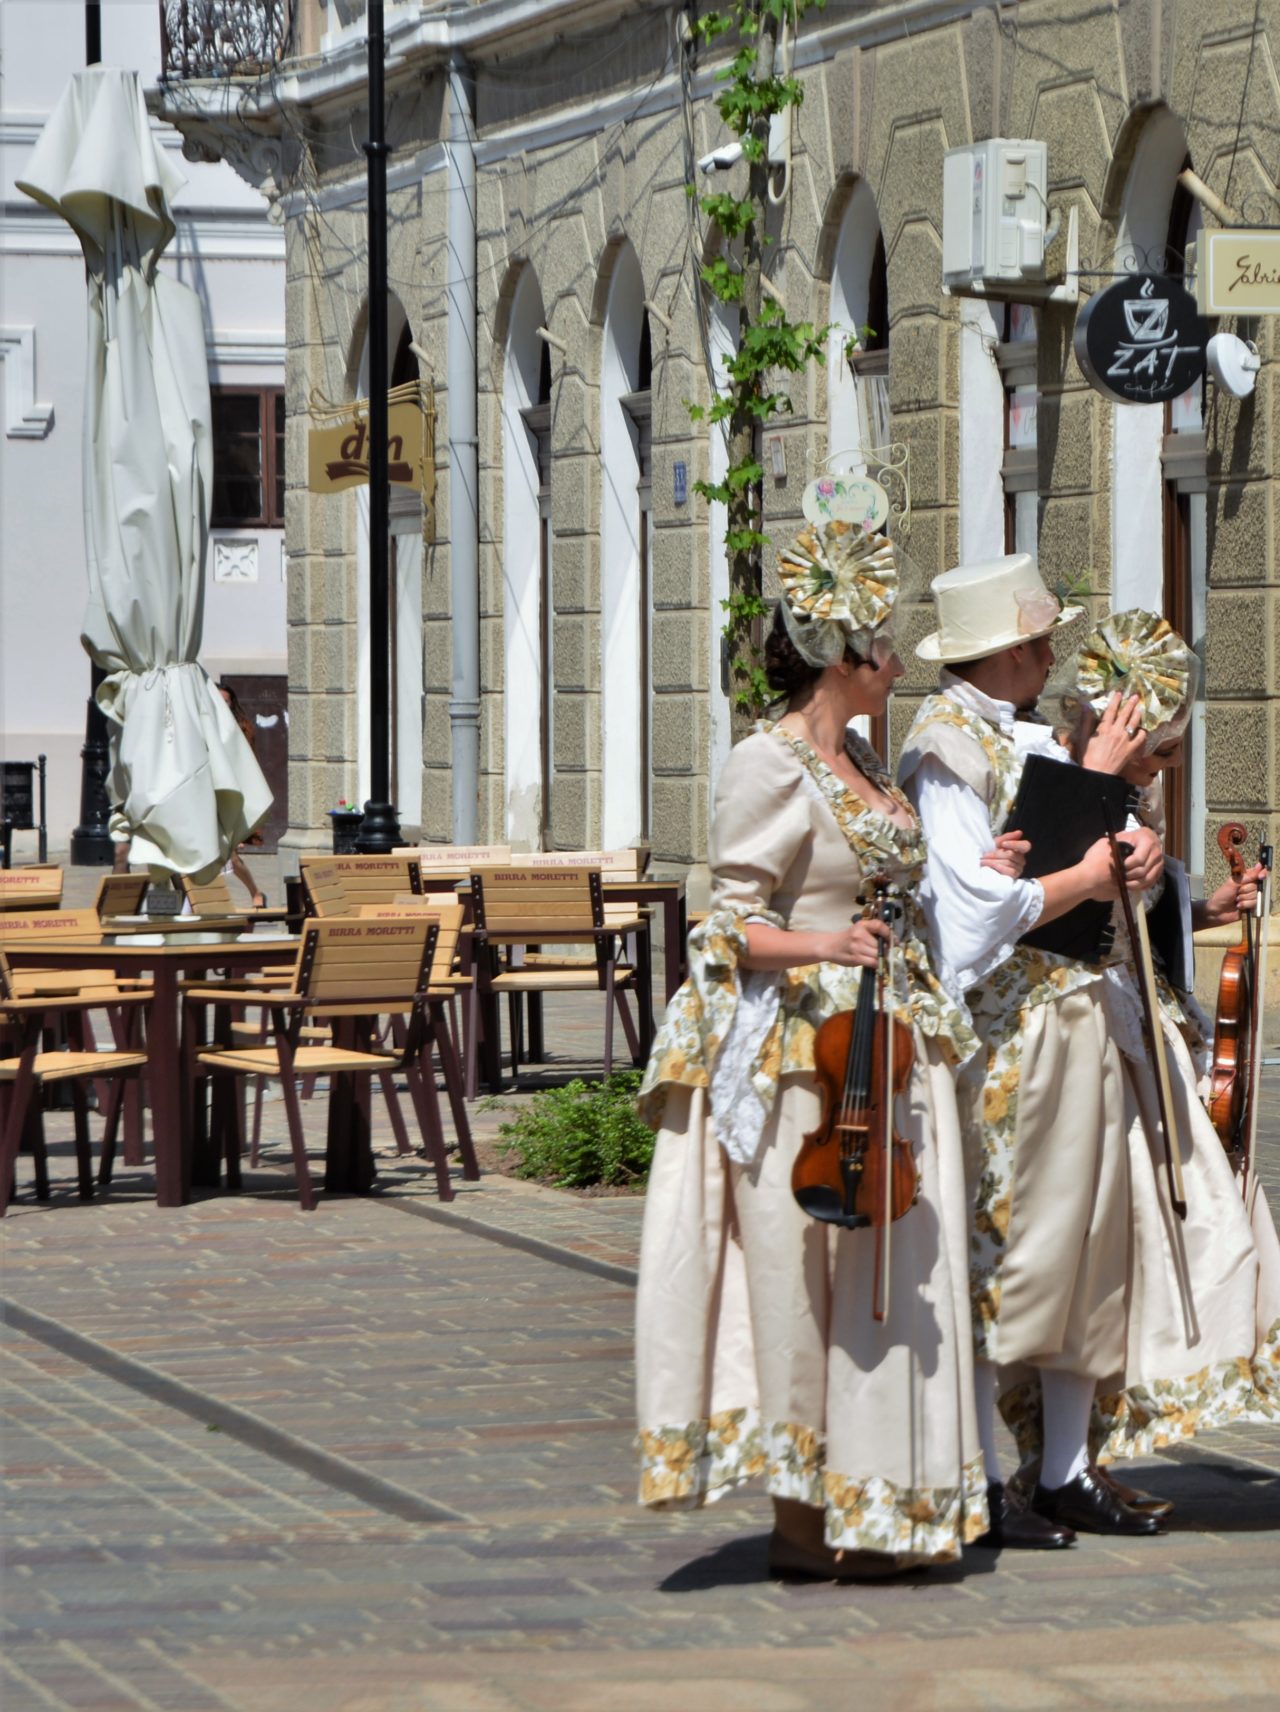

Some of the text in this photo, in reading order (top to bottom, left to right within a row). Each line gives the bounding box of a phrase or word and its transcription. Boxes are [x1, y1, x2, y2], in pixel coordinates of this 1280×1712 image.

[1106, 345, 1201, 382] ZAT
[355, 862, 400, 871] MORETTI
[494, 872, 579, 881] BIRRA MORETTI
[328, 925, 415, 938] BIRRA MORETTI
